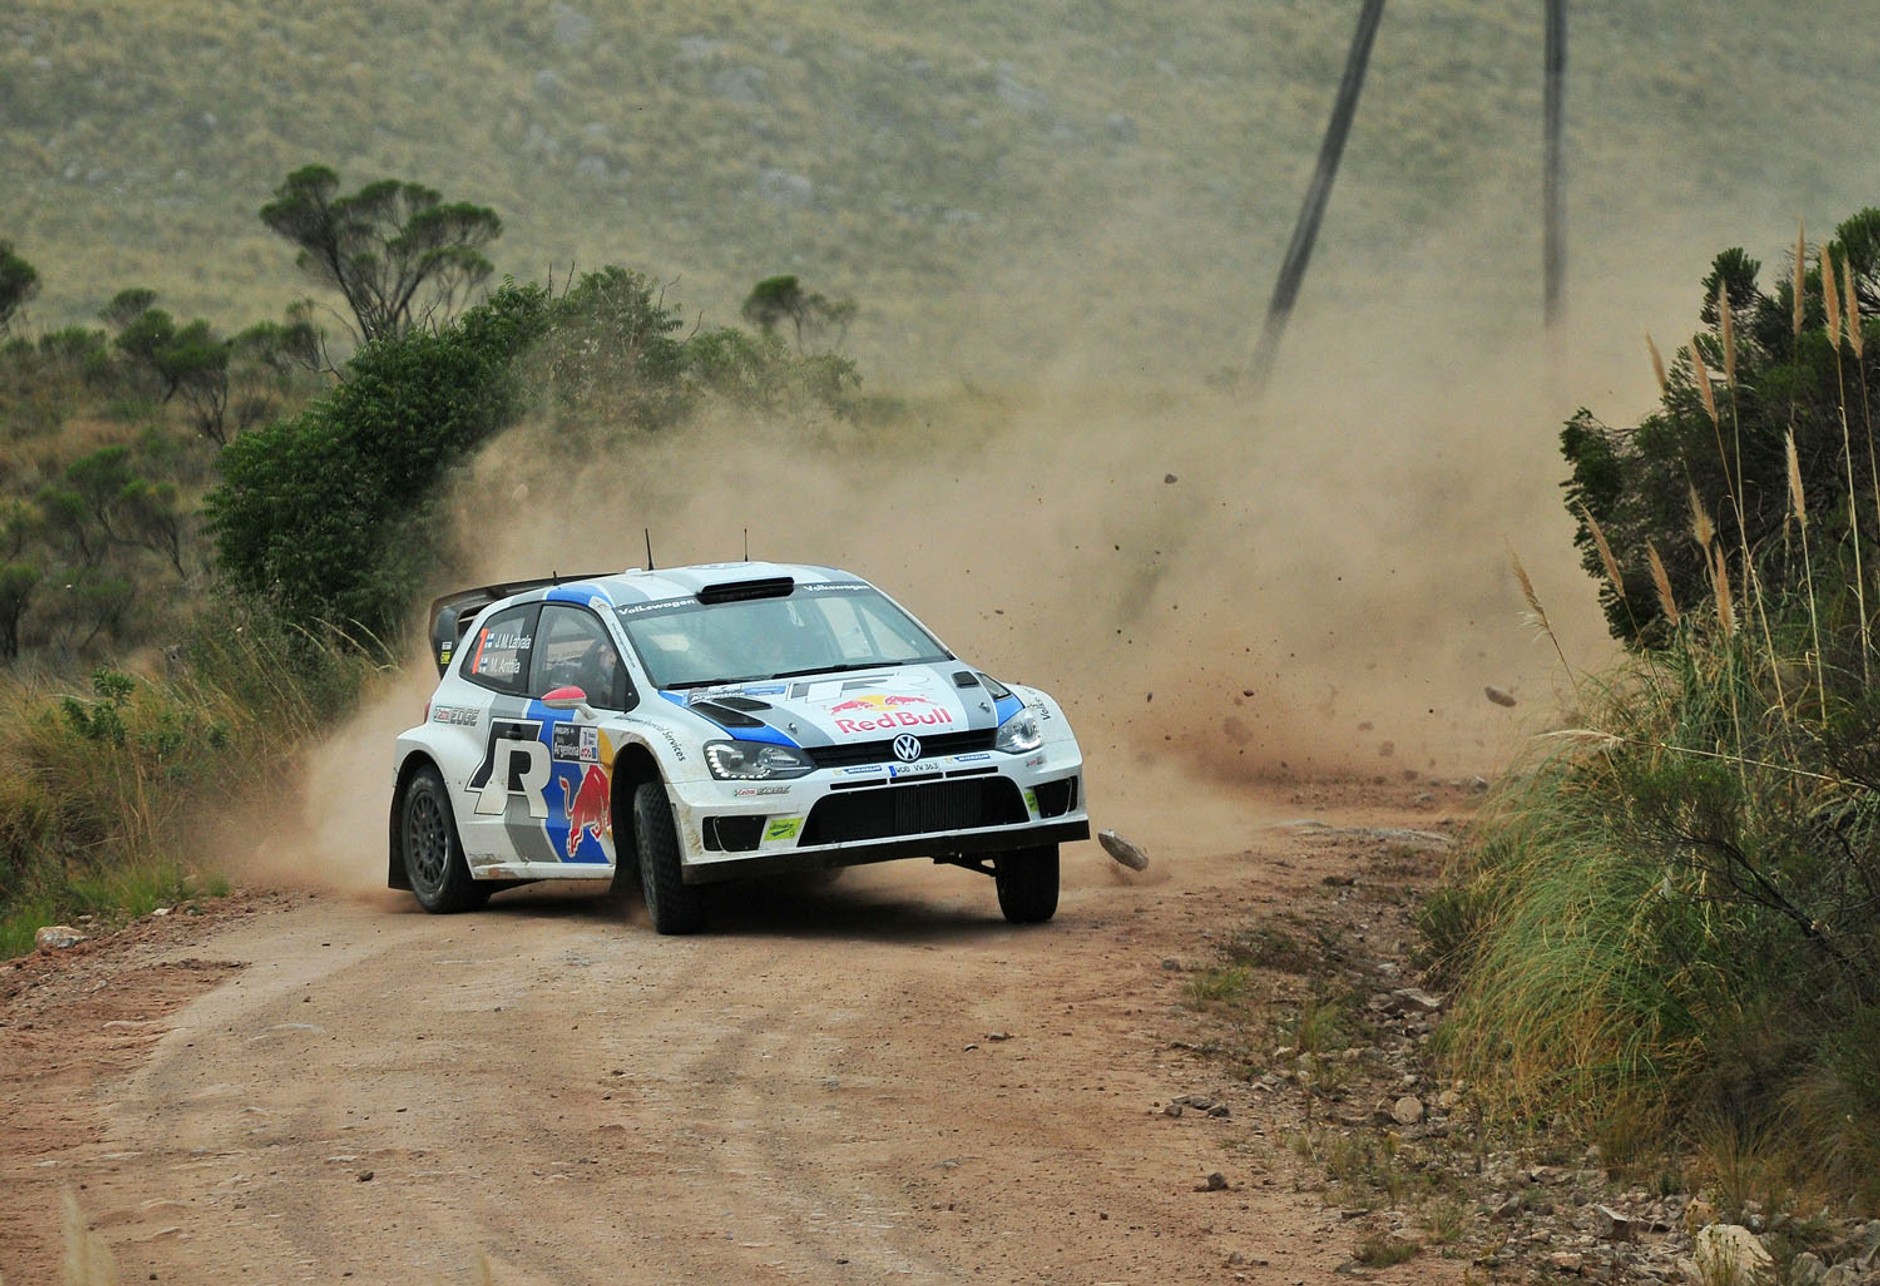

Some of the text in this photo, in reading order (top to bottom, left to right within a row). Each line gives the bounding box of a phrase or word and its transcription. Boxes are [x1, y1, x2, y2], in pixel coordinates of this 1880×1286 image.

[835, 708, 953, 734] Red Bull
[662, 730, 687, 762] Services
[467, 717, 552, 819] R
